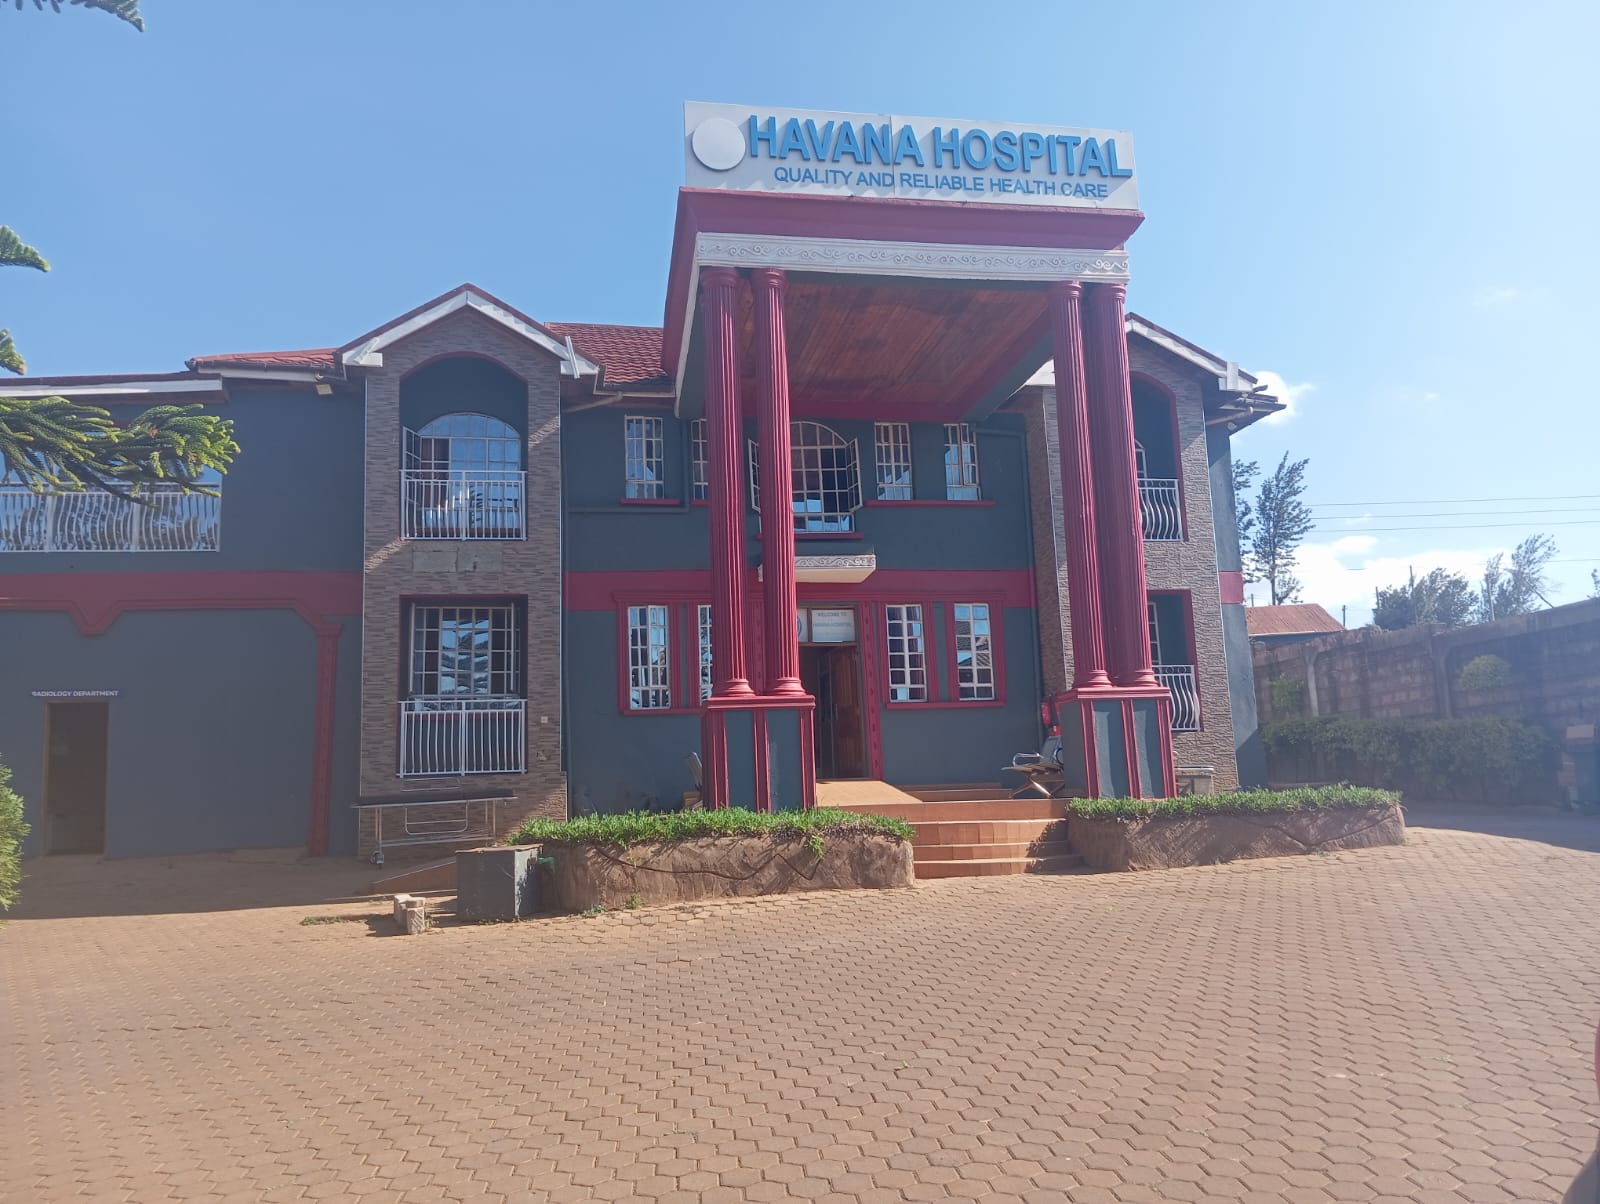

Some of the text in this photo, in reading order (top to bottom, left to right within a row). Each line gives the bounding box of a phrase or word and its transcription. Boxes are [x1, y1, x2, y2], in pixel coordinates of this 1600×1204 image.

[749, 115, 1133, 178] HAVANA HOSPITAL
[774, 166, 1108, 198] QUALITY AND RELIABLE HEALTH CARE
